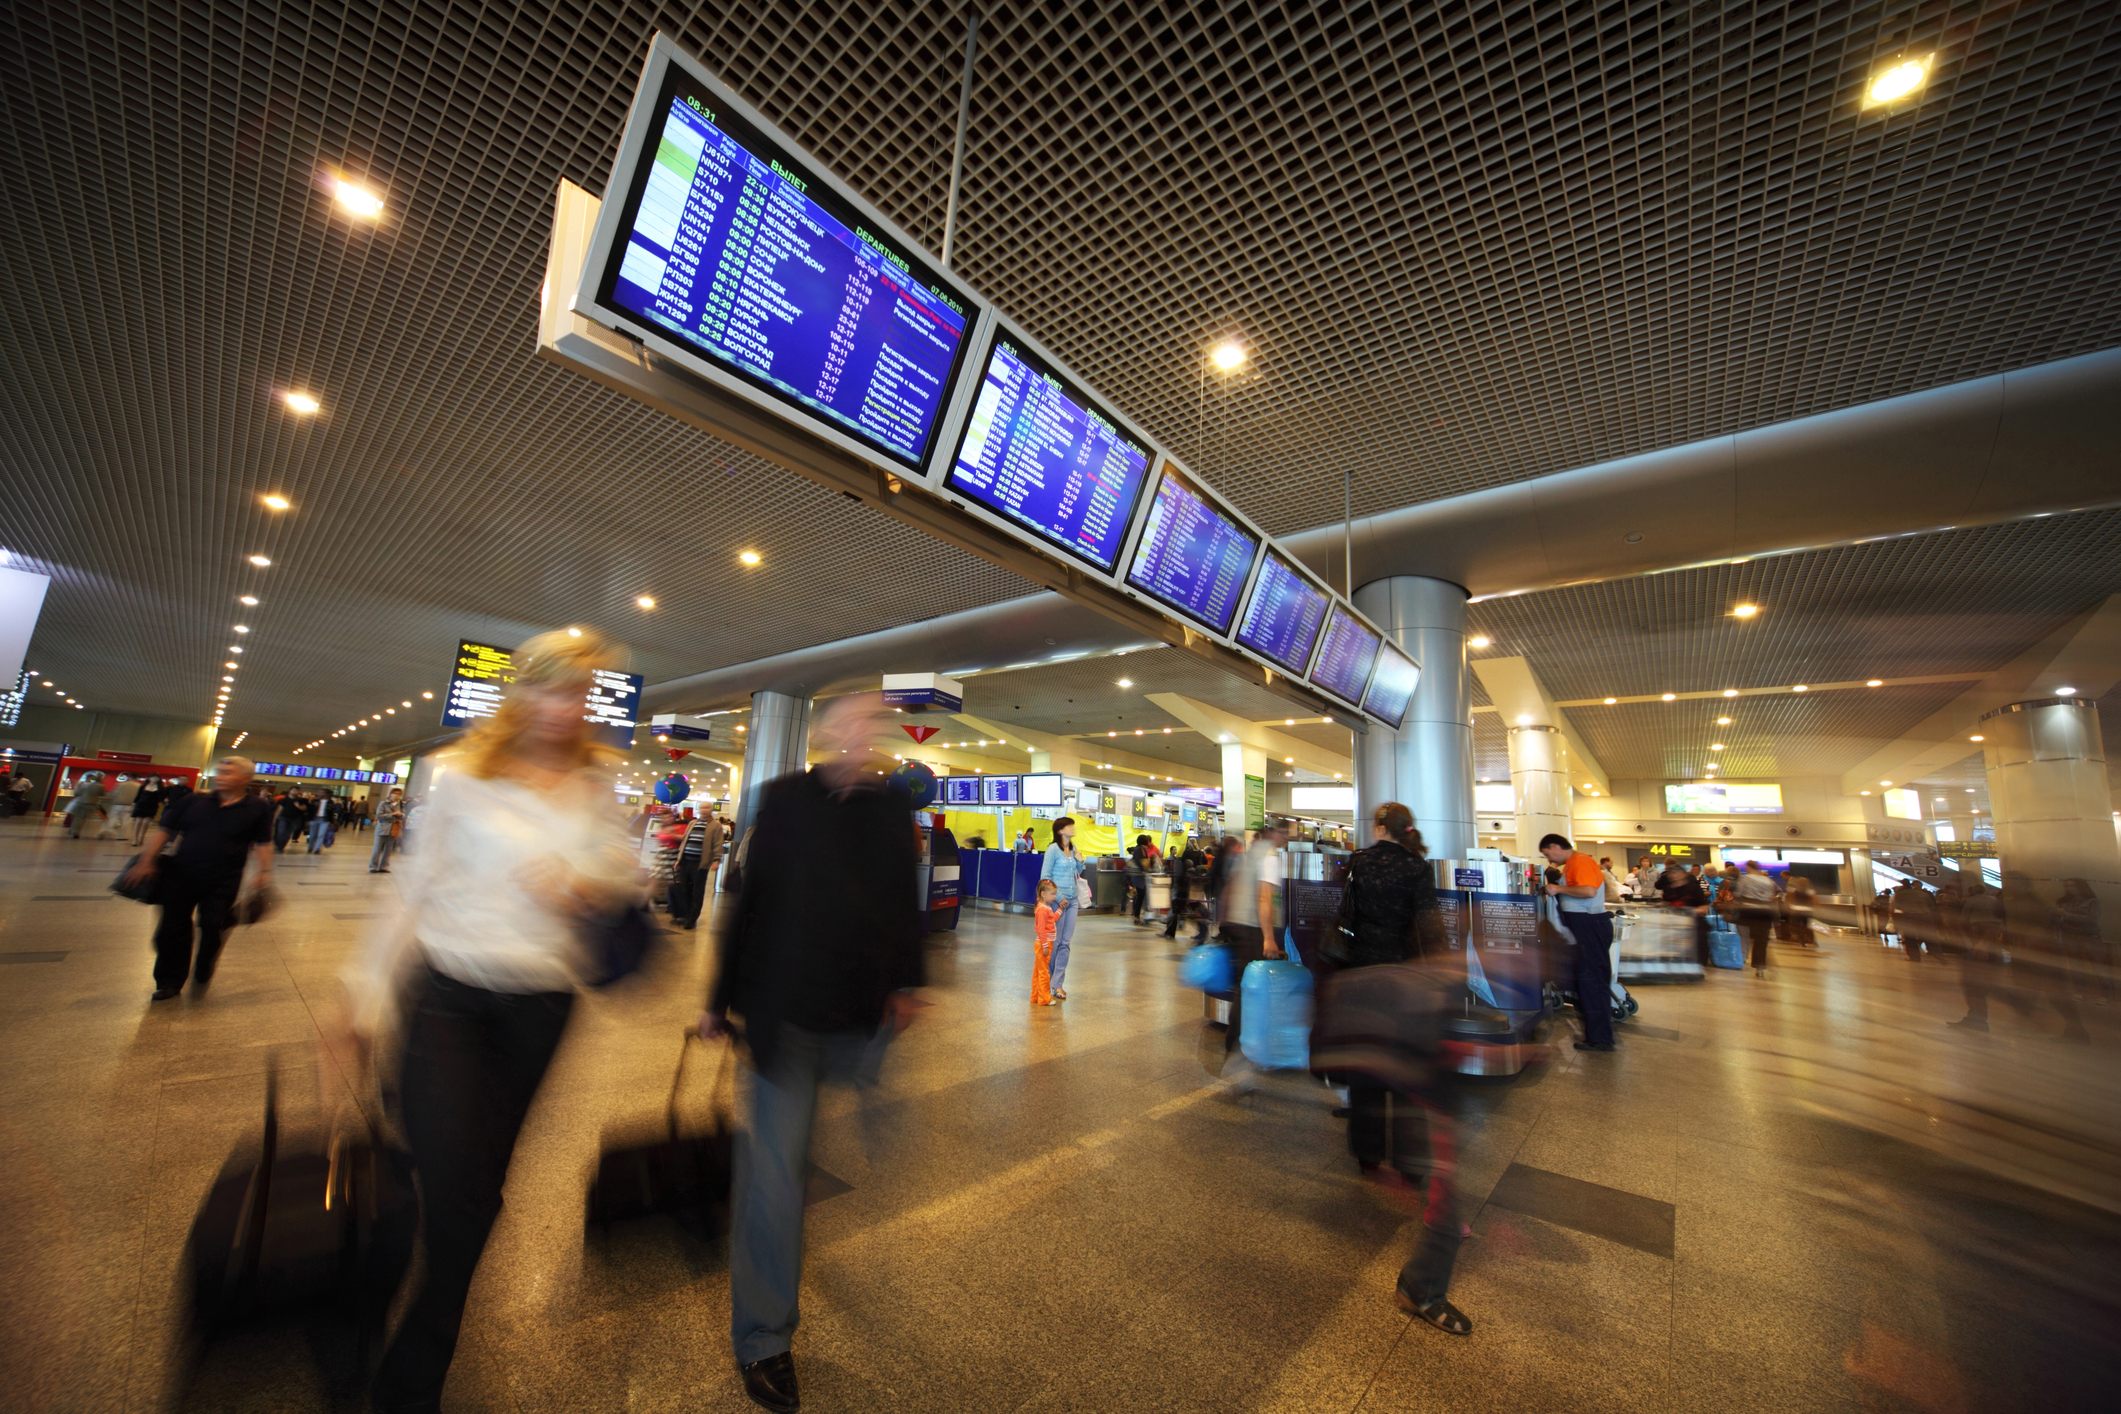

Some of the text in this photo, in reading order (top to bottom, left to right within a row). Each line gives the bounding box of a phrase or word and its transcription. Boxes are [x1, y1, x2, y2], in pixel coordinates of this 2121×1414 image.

[686, 94, 716, 123] 08:31
[719, 143, 736, 160] Flight
[722, 135, 737, 151] Рейс
[747, 164, 762, 178] Time
[749, 157, 769, 175] Время
[770, 158, 807, 193] ВЫЛЕТ
[703, 142, 730, 168] U6101
[745, 173, 769, 197] 22:10
[768, 191, 825, 239] НОВОКУЗНЕЦК
[734, 205, 759, 228] 08:55
[700, 153, 935, 333] NN7871 08:35 БУРГАС 1-3 Выход закрыт
[728, 226, 752, 249] 09:00
[752, 243, 777, 265] СОЧИ
[855, 225, 910, 273] DEPARTURES
[696, 164, 719, 187] S710
[738, 194, 762, 217] 08:50
[762, 212, 811, 252] ЧЕЛЯБИНСК
[892, 306, 928, 338] Регистрация
[927, 333, 950, 353] закрыта
[731, 215, 756, 238] 09:00
[755, 233, 789, 263] ЛИПЕЦК
[844, 294, 863, 312] 10-11
[682, 209, 939, 386] UN141 09:00 СОЧИ 23-24 Регистрация закрыта
[721, 247, 746, 270] 09:05
[745, 264, 786, 296] ВОРОНЕЖ
[835, 322, 854, 340] 12-17
[878, 350, 904, 372] Посадка
[675, 231, 703, 255] U6261
[717, 258, 742, 280] 09:05
[742, 274, 803, 318] ЕКАТЕРИНБУРГ
[875, 359, 904, 383] Пройдите
[907, 381, 929, 400] выходу
[714, 269, 739, 290] 09:10
[739, 284, 794, 325] НИЖНЕКАМСК
[829, 341, 848, 358] 10-11
[872, 368, 898, 389] Посадка
[707, 290, 732, 311] 09:20
[732, 305, 760, 328] КУРСК
[823, 360, 842, 377] 12-17
[866, 386, 896, 409] Пройдите
[899, 407, 921, 425] выходу
[711, 279, 736, 301] 09:15
[735, 295, 770, 322] НЯГАНЬ
[826, 350, 845, 367] 12-17
[869, 377, 899, 400] Пройдите
[902, 398, 924, 416] выходу
[1002, 340, 1017, 357] 08:31
[704, 301, 729, 322] 09:20
[729, 316, 768, 344] САРАТОВ
[820, 369, 839, 386] 12-17
[863, 395, 900, 423] Регистрация
[697, 322, 723, 342] 09:25
[722, 336, 771, 370] ВОЛГОГРАД
[814, 388, 833, 404] 12-17
[857, 412, 887, 435] Пройдите
[890, 432, 913, 449] выходу
[701, 312, 726, 332] 09:25
[725, 326, 774, 361] ВОЛГОГРАД
[817, 379, 836, 395] 12-17
[860, 403, 890, 426] Пройдите
[893, 424, 915, 441] выходу
[1042, 372, 1062, 392] ВЫЛЕТ
[1086, 407, 1116, 435] DEPARTURES
[1023, 445, 1038, 459] ANAPA
[1005, 496, 1021, 509] KAZAN
[1008, 489, 1023, 502] KAZAN
[1104, 797, 1114, 808] 33
[1135, 801, 1143, 812] 34
[1198, 811, 1206, 821] 35
[1650, 844, 1667, 855] 44
[1900, 856, 1912, 867] A
[1926, 866, 1938, 876] B
